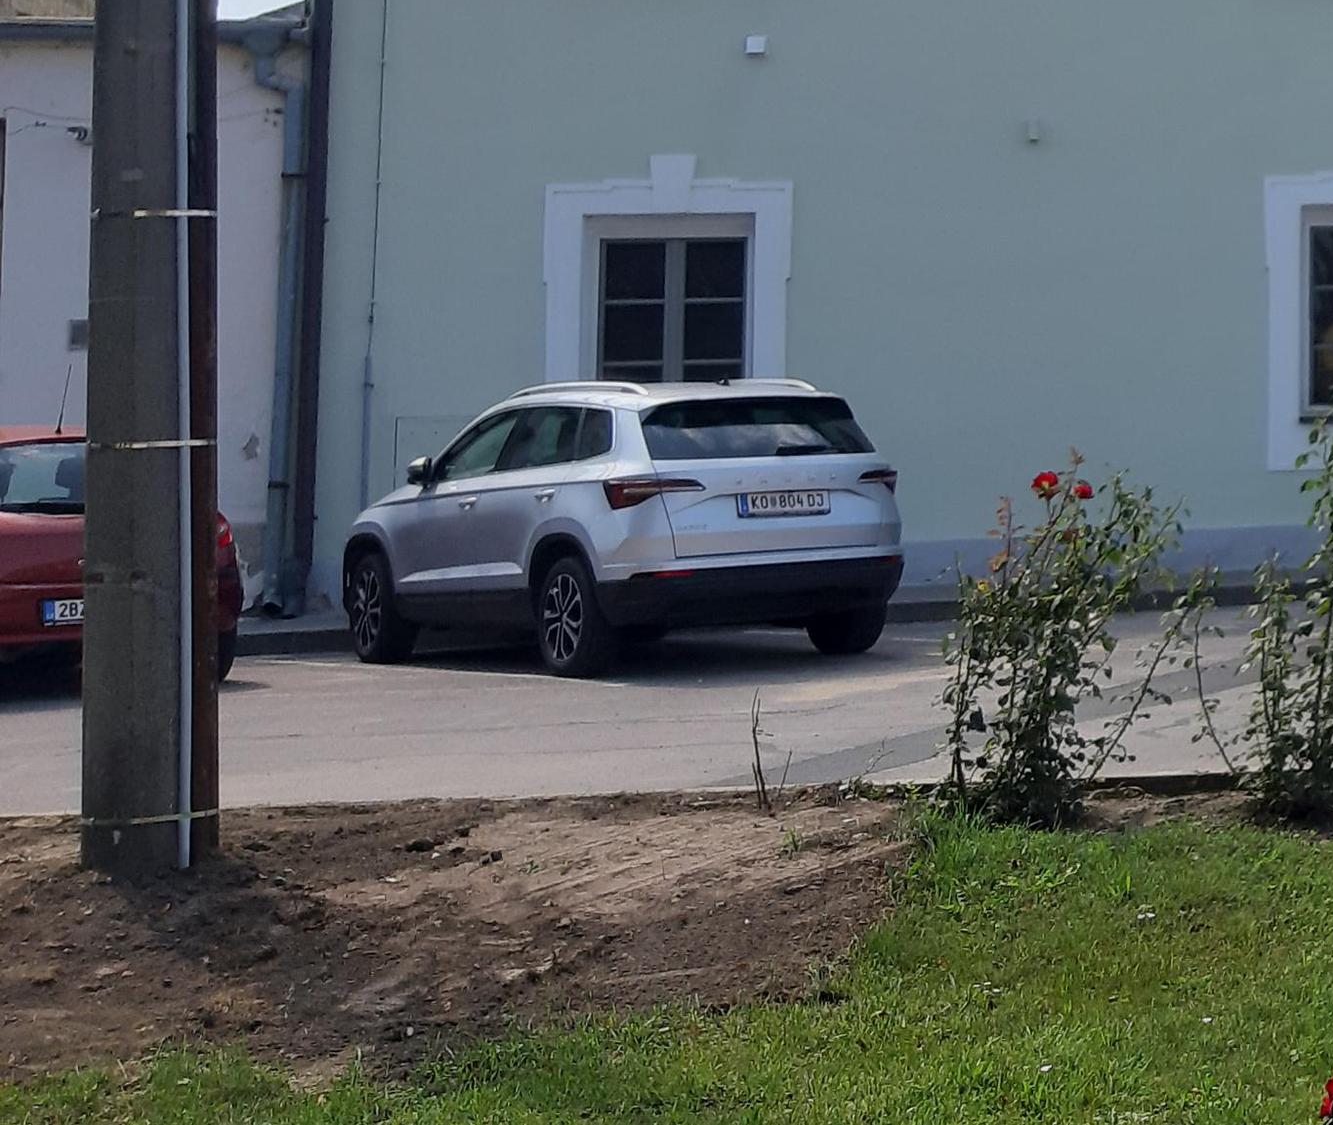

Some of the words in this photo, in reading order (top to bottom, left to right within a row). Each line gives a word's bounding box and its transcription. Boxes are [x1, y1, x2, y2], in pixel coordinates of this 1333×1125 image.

[751, 494, 769, 509] KO
[779, 493, 804, 508] 804
[807, 493, 824, 508] DJ
